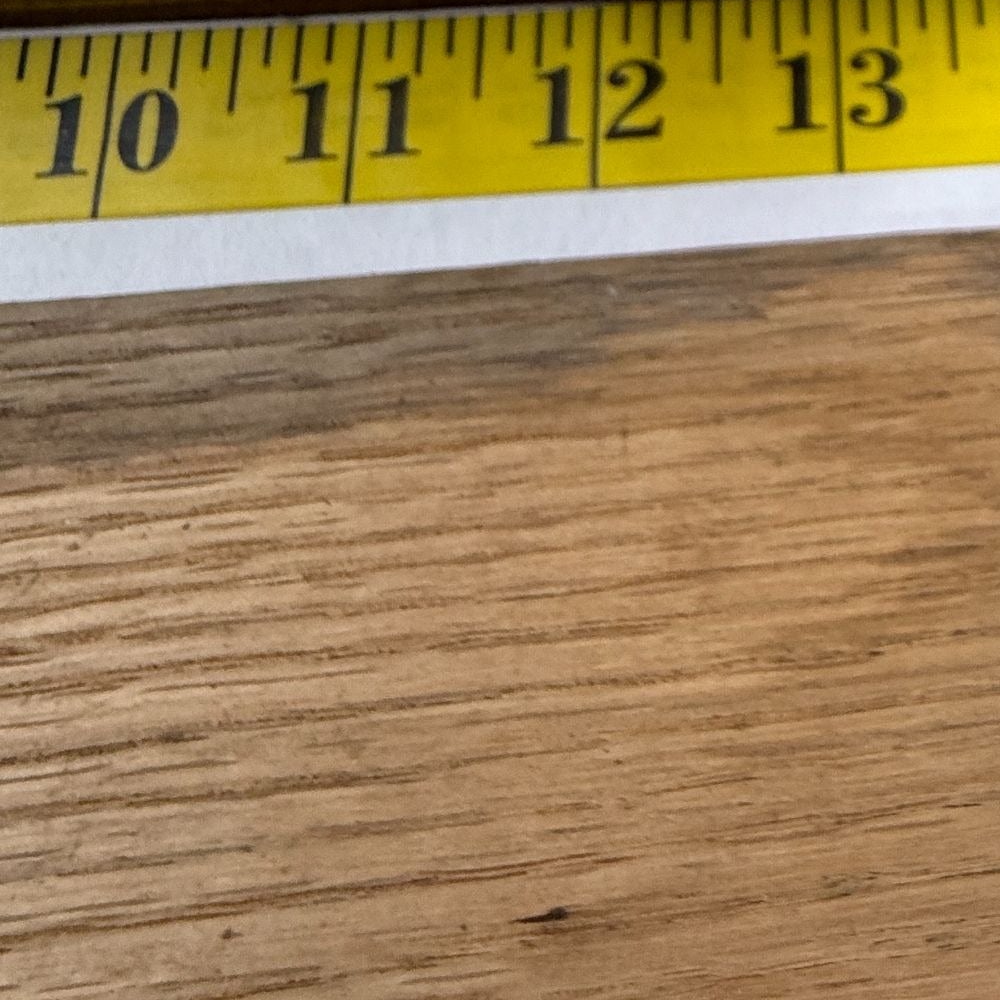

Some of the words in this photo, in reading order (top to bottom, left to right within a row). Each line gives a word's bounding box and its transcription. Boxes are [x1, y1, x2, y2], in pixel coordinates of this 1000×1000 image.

[34, 88, 181, 179] 10
[285, 76, 421, 164] 11
[532, 58, 666, 146] 12
[776, 46, 907, 133] 13
